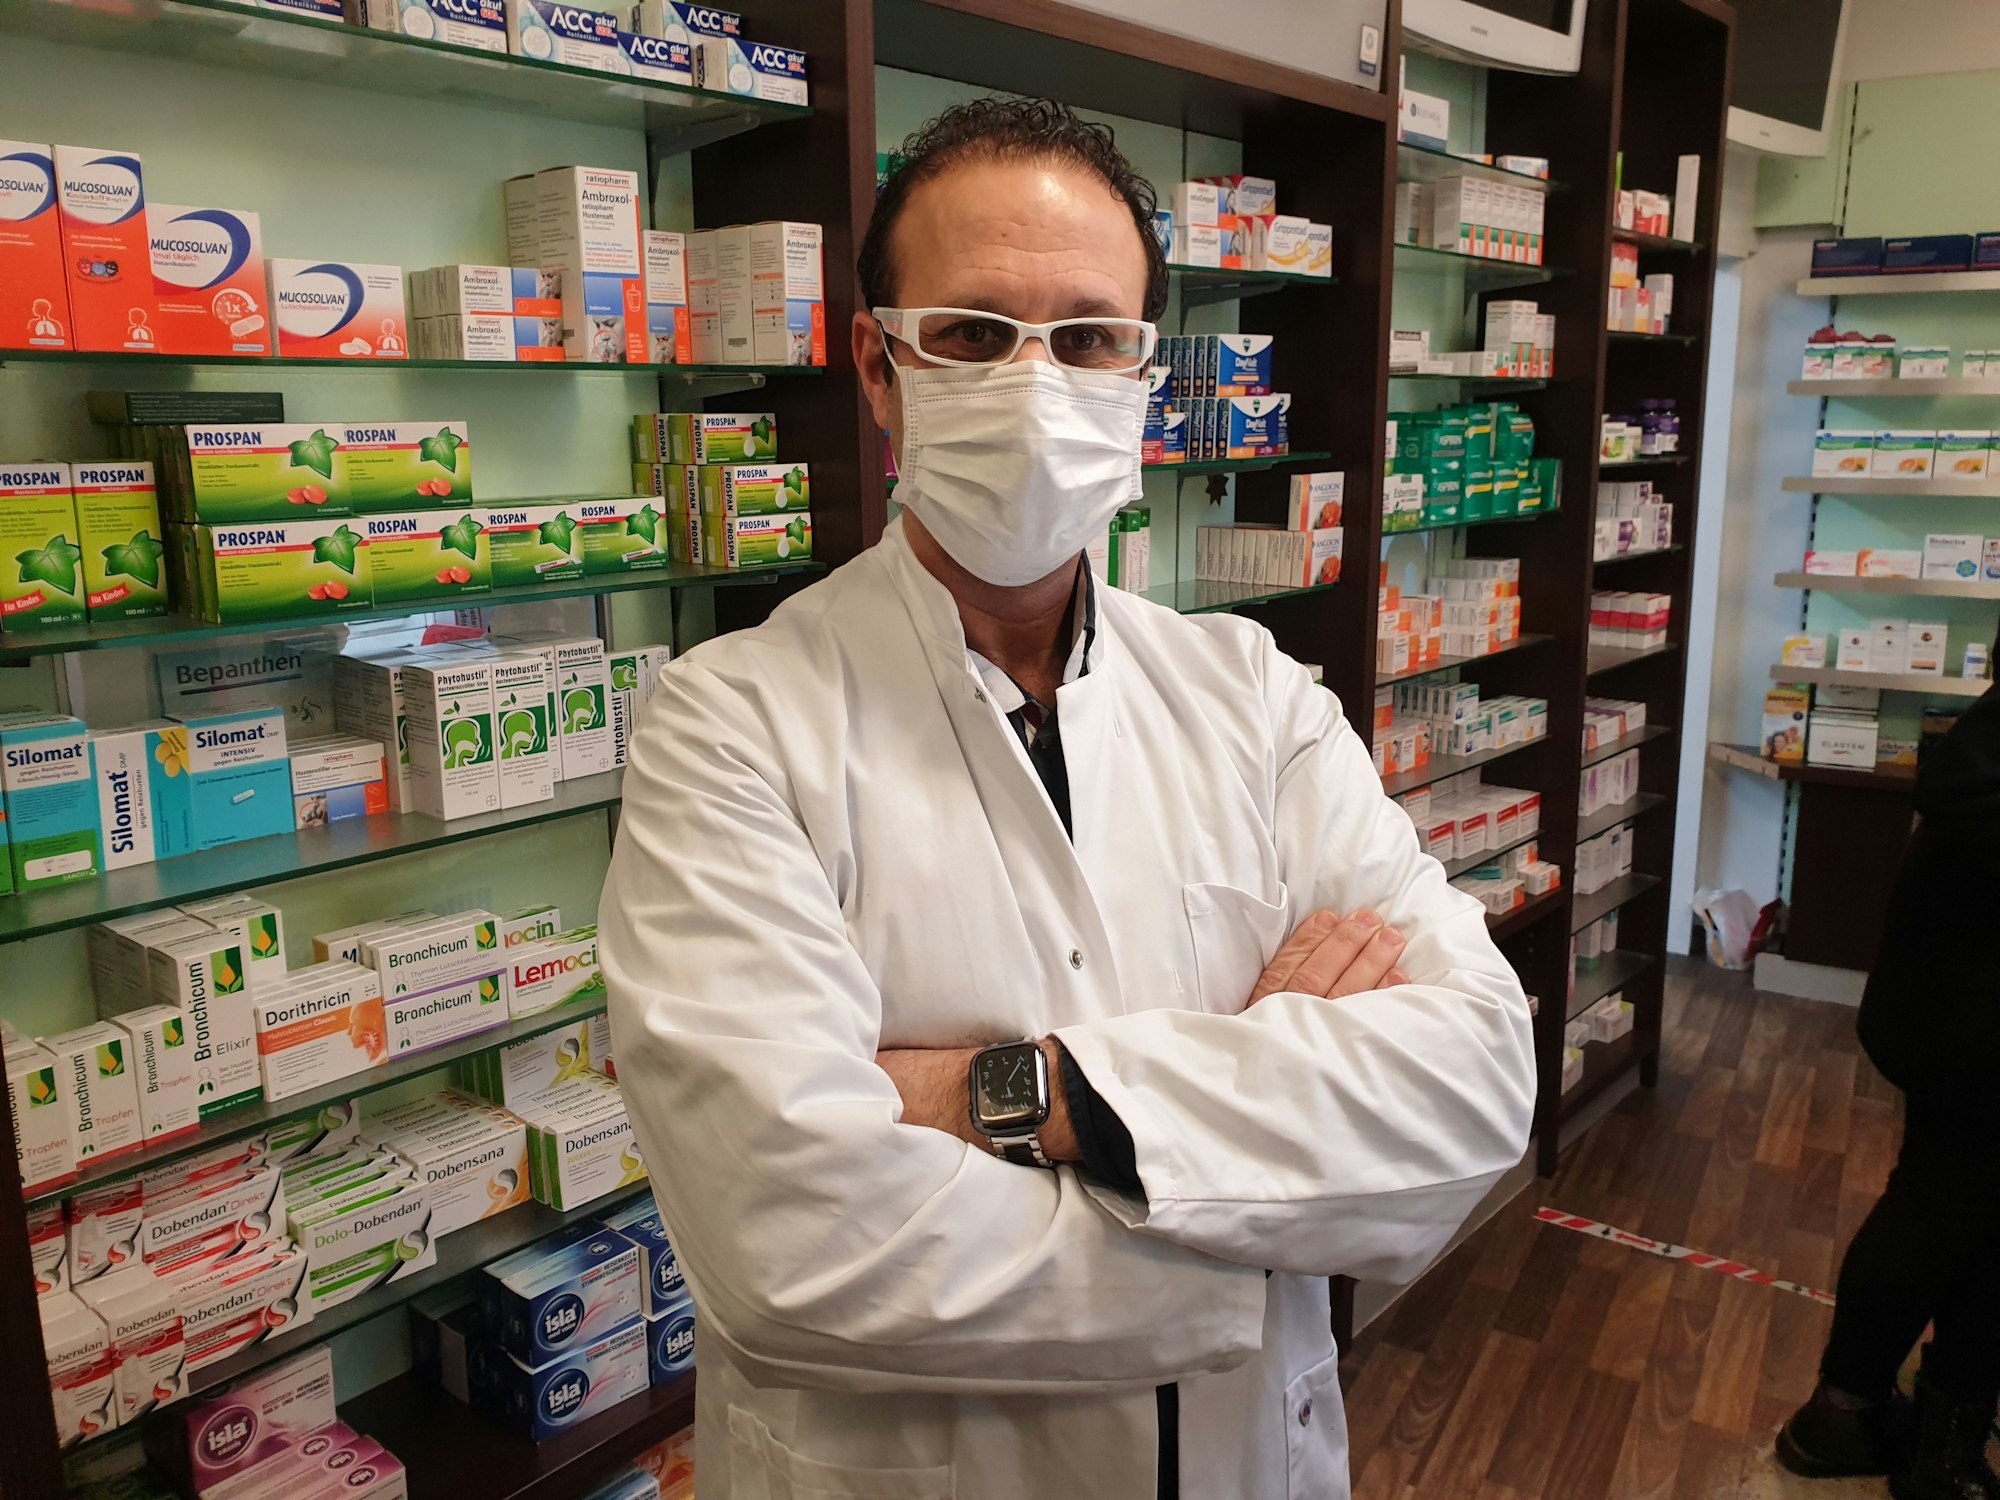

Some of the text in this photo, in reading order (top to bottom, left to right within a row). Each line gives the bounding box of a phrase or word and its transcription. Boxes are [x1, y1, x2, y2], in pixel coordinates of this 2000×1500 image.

[550, 6, 593, 33] ACC
[595, 16, 617, 28] akut
[686, 7, 721, 30] ACC
[722, 15, 741, 26] akut
[630, 36, 669, 61] ACC
[670, 44, 690, 55] akut
[751, 46, 787, 70] ACC
[787, 53, 805, 64] akut
[64, 180, 134, 197] MUCOSOLVAN
[586, 175, 629, 186] ratiopharm
[582, 190, 632, 204] Ambroxol-
[582, 204, 613, 213] ratiopharm
[582, 211, 613, 220] Hustensaft
[150, 239, 228, 255] MUCOSOLVAN
[648, 246, 681, 256] Ambroxol-
[786, 239, 818, 250] Ambroxol-
[173, 253, 200, 263] täglich
[464, 276, 500, 285] Ambroxol-
[225, 301, 241, 314] 1x
[279, 292, 345, 305] MUCOSOLVAN
[467, 325, 503, 334] Ambroxol-
[706, 418, 736, 426] PROSPAN
[194, 431, 262, 446] PROSPAN
[658, 419, 667, 457] PROSPAN
[694, 419, 703, 459] PROSPAN
[80, 468, 145, 483] PROSPAN
[737, 469, 768, 478] PROSPAN
[688, 470, 697, 509] PROSPAN
[725, 471, 734, 511] PROSPAN
[739, 519, 770, 529] PROSPAN
[218, 529, 285, 547] PROSPAN
[691, 520, 699, 558] PROSPAN
[727, 523, 735, 562] PROSPAN
[16, 594, 41, 610] Kinder
[91, 586, 125, 604] für Kinder
[41, 615, 52, 623] 100
[125, 608, 136, 616] 100
[558, 646, 599, 658] Phytohustil
[176, 653, 301, 685] Bepanthen
[438, 670, 485, 686] Phytohustil
[495, 663, 540, 678] Phytohustil
[438, 680, 489, 692] Hustenreizstiller Sirup
[496, 675, 531, 685] Hustenreizstiller
[196, 725, 265, 748] Silomat
[612, 696, 626, 765] Phytohustil
[6, 743, 83, 768] Silomat
[213, 753, 264, 767] gegen Reizhusten
[220, 747, 256, 758] INTENSIV
[295, 766, 331, 776] Hustenstiller
[108, 771, 134, 853] Silomat
[139, 807, 147, 829] gegen
[388, 938, 468, 969] Bronchicum
[410, 965, 439, 978] Thymian
[514, 943, 597, 988] Lemoci
[188, 962, 212, 1062] Bronchicum
[265, 991, 351, 1026] Dorithricin
[394, 992, 472, 1025] Bronchicum
[216, 1036, 251, 1056] Elixir
[143, 1030, 159, 1094] Bronchicum
[160, 1074, 192, 1089] Tropfen
[73, 1054, 93, 1133] Bronchicum
[543, 1088, 593, 1110] Dobensana
[95, 1109, 134, 1125] Tropfen
[414, 1113, 470, 1135] Dobensana
[426, 1119, 481, 1143] Dobensana
[437, 1127, 492, 1151] Dobensana
[26, 1138, 67, 1156] Tropfen
[427, 1147, 505, 1184] Dobensana
[151, 1202, 227, 1240] Dobendan
[231, 1191, 266, 1211] Direkt
[315, 1200, 421, 1249] Dolo-Dobendan
[604, 1253, 632, 1270] HEISERKEIT
[581, 1257, 637, 1289] STIMMBESCHWERDEN
[257, 1278, 293, 1298] Direkt
[116, 1307, 176, 1337] Dobendan
[545, 1307, 577, 1334] isla
[609, 1327, 639, 1345] HEISERKEIT
[666, 1330, 694, 1355] isla
[586, 1332, 645, 1363] STIMMBESCHWERDEN
[548, 1382, 581, 1409] isla
[208, 1418, 247, 1452] isla
